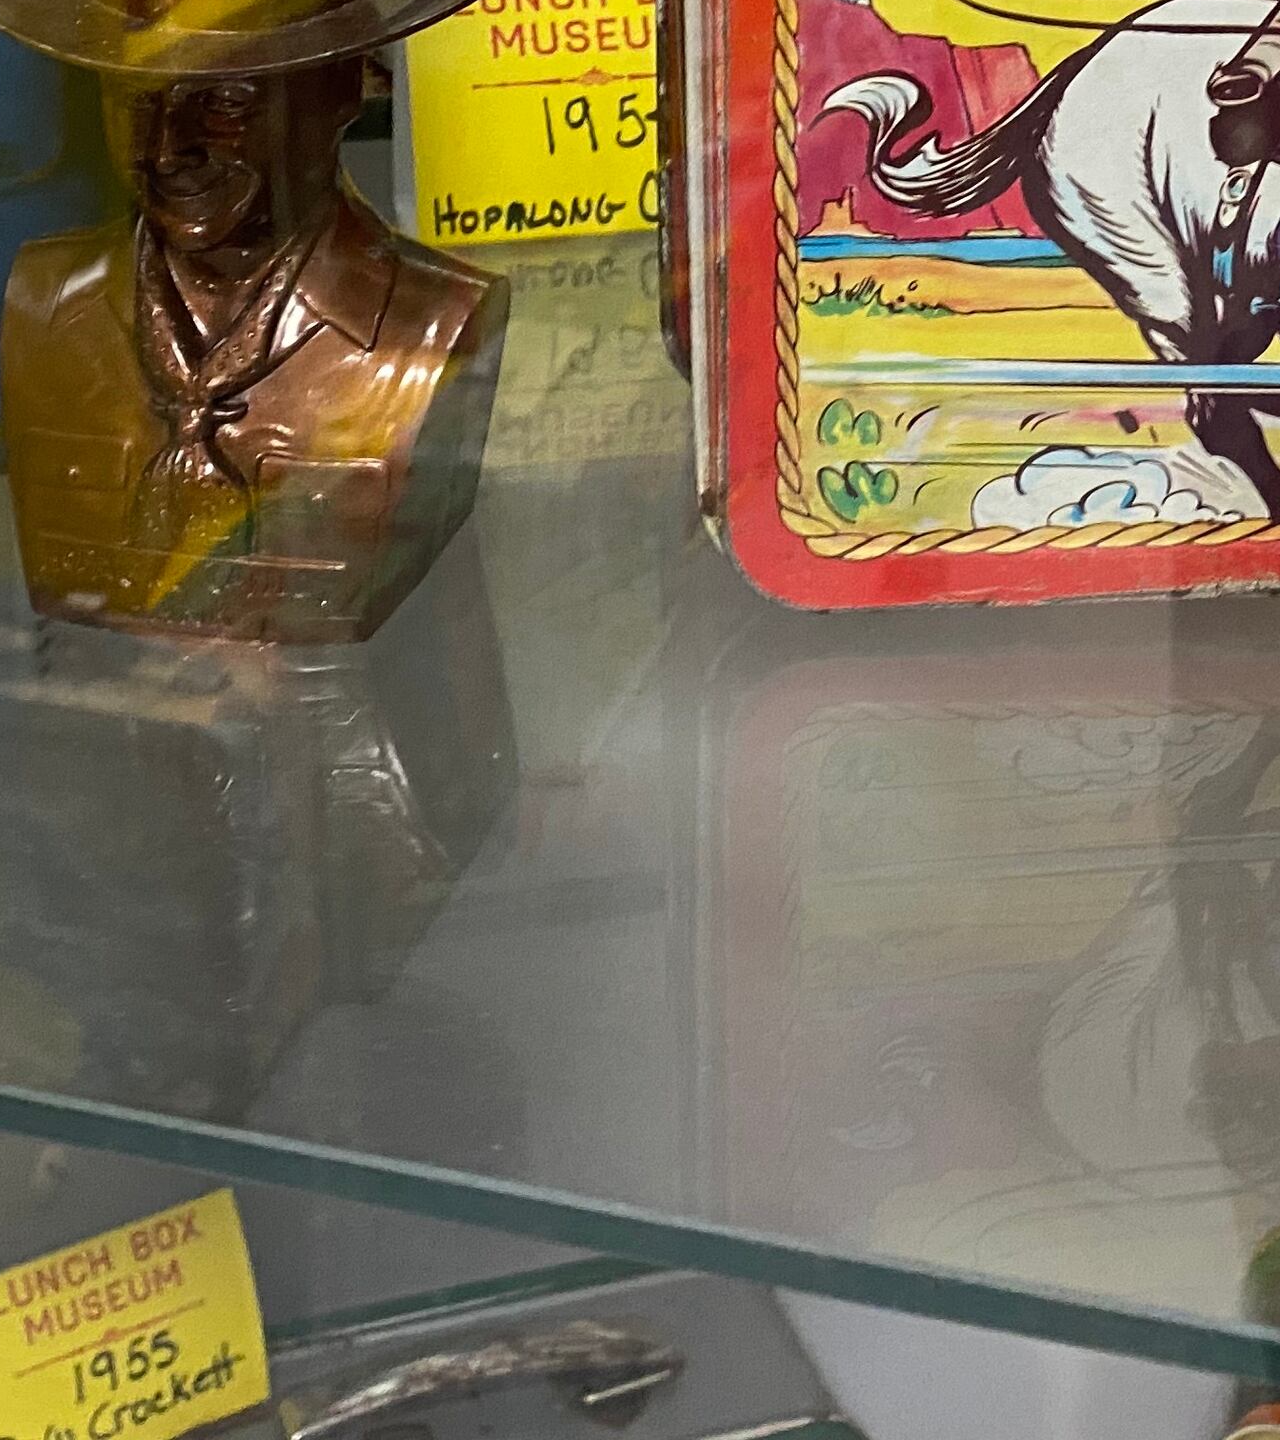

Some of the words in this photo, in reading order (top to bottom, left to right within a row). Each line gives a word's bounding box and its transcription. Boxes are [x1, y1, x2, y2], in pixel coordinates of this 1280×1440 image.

[490, 14, 653, 58] MUSEU
[543, 93, 657, 156] 195
[432, 192, 628, 237] HOPALONG
[130, 1208, 202, 1262] BOX
[22, 1258, 184, 1346] MUSEUM
[72, 1328, 181, 1405] 1955
[87, 1340, 246, 1440] Crockett
